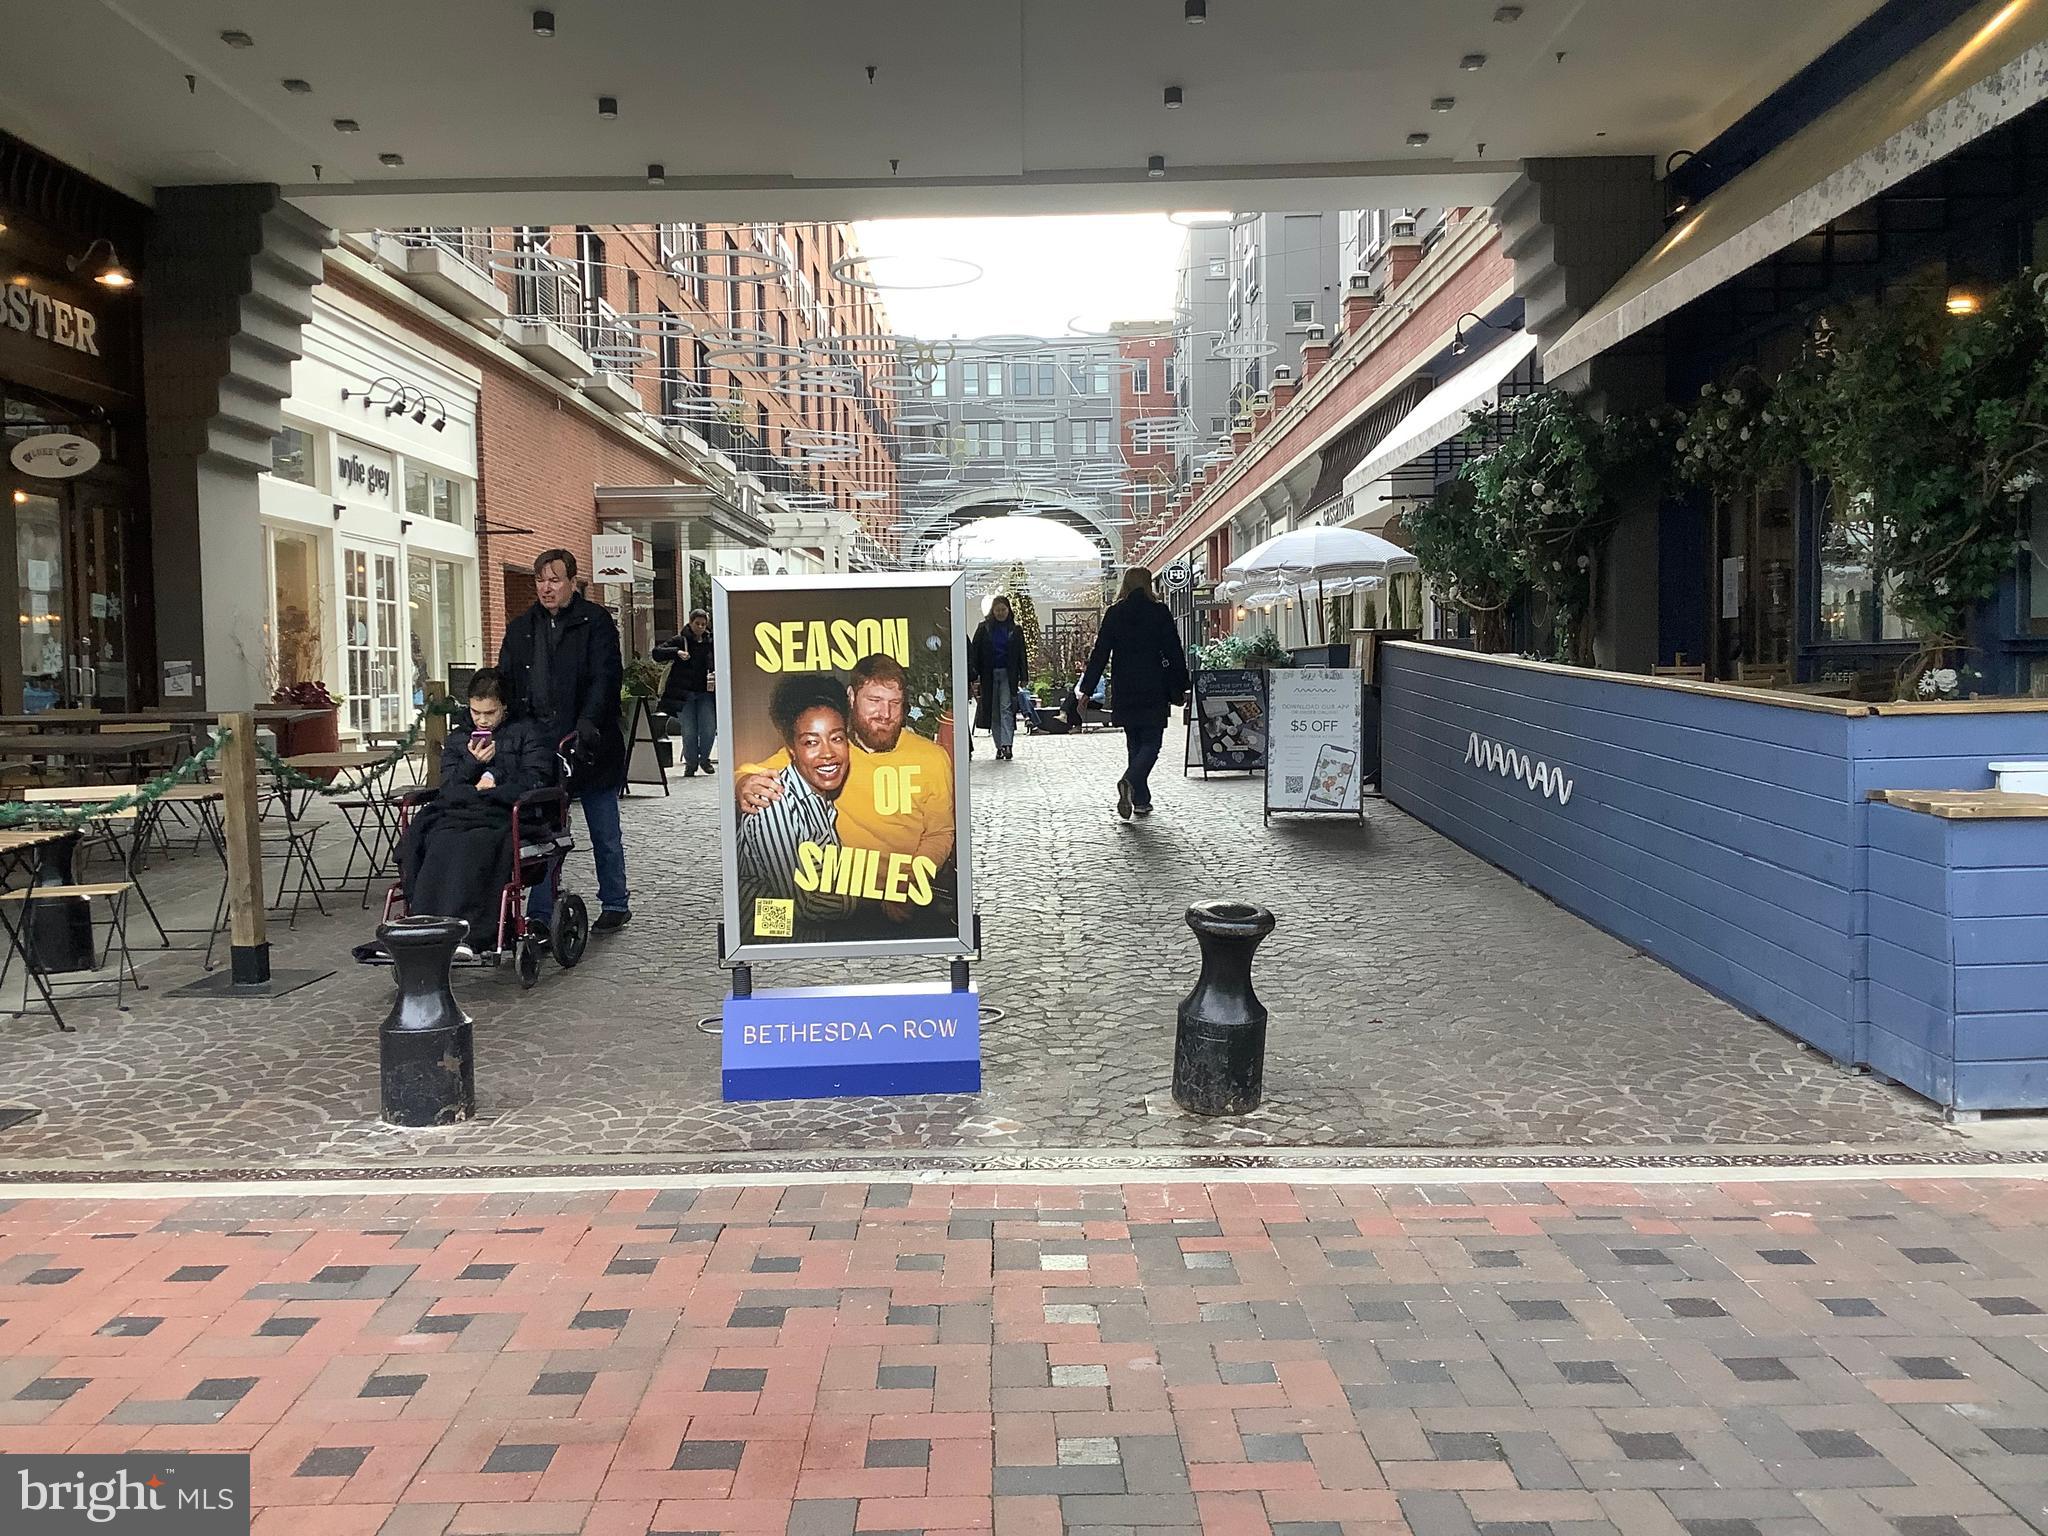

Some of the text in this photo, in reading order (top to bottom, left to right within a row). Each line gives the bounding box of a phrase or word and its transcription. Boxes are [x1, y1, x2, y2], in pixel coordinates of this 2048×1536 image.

[338, 454, 390, 497] wylie grey
[754, 617, 910, 674] SEASON
[1290, 719, 1339, 732] $5 OFF
[873, 765, 922, 817] OF
[794, 841, 938, 906] SMILES
[743, 1018, 959, 1046] BETHESDA ROW
